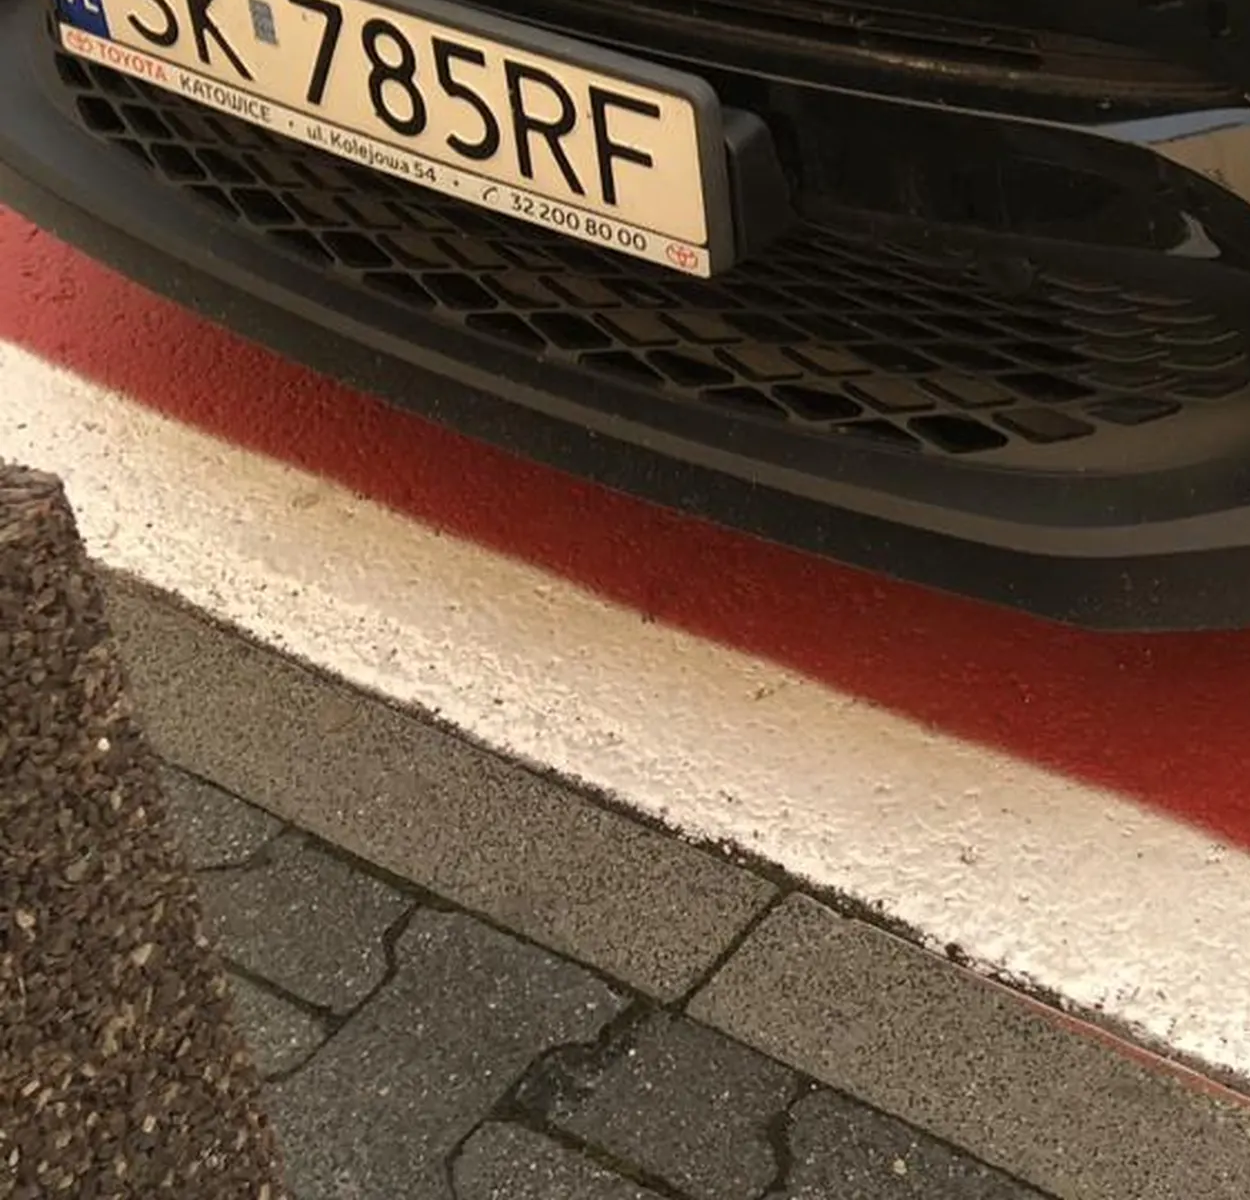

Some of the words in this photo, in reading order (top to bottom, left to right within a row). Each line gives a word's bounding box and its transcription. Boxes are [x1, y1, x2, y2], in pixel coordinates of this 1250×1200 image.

[98, 42, 169, 82] TOYOTA
[179, 73, 272, 123] KATOWICE
[306, 125, 328, 145] ul.
[329, 131, 410, 174] Kolejowa
[413, 161, 438, 183] 54
[510, 191, 537, 215] 32
[539, 203, 581, 232] 200
[585, 218, 613, 240] 80
[617, 228, 648, 252] 00
